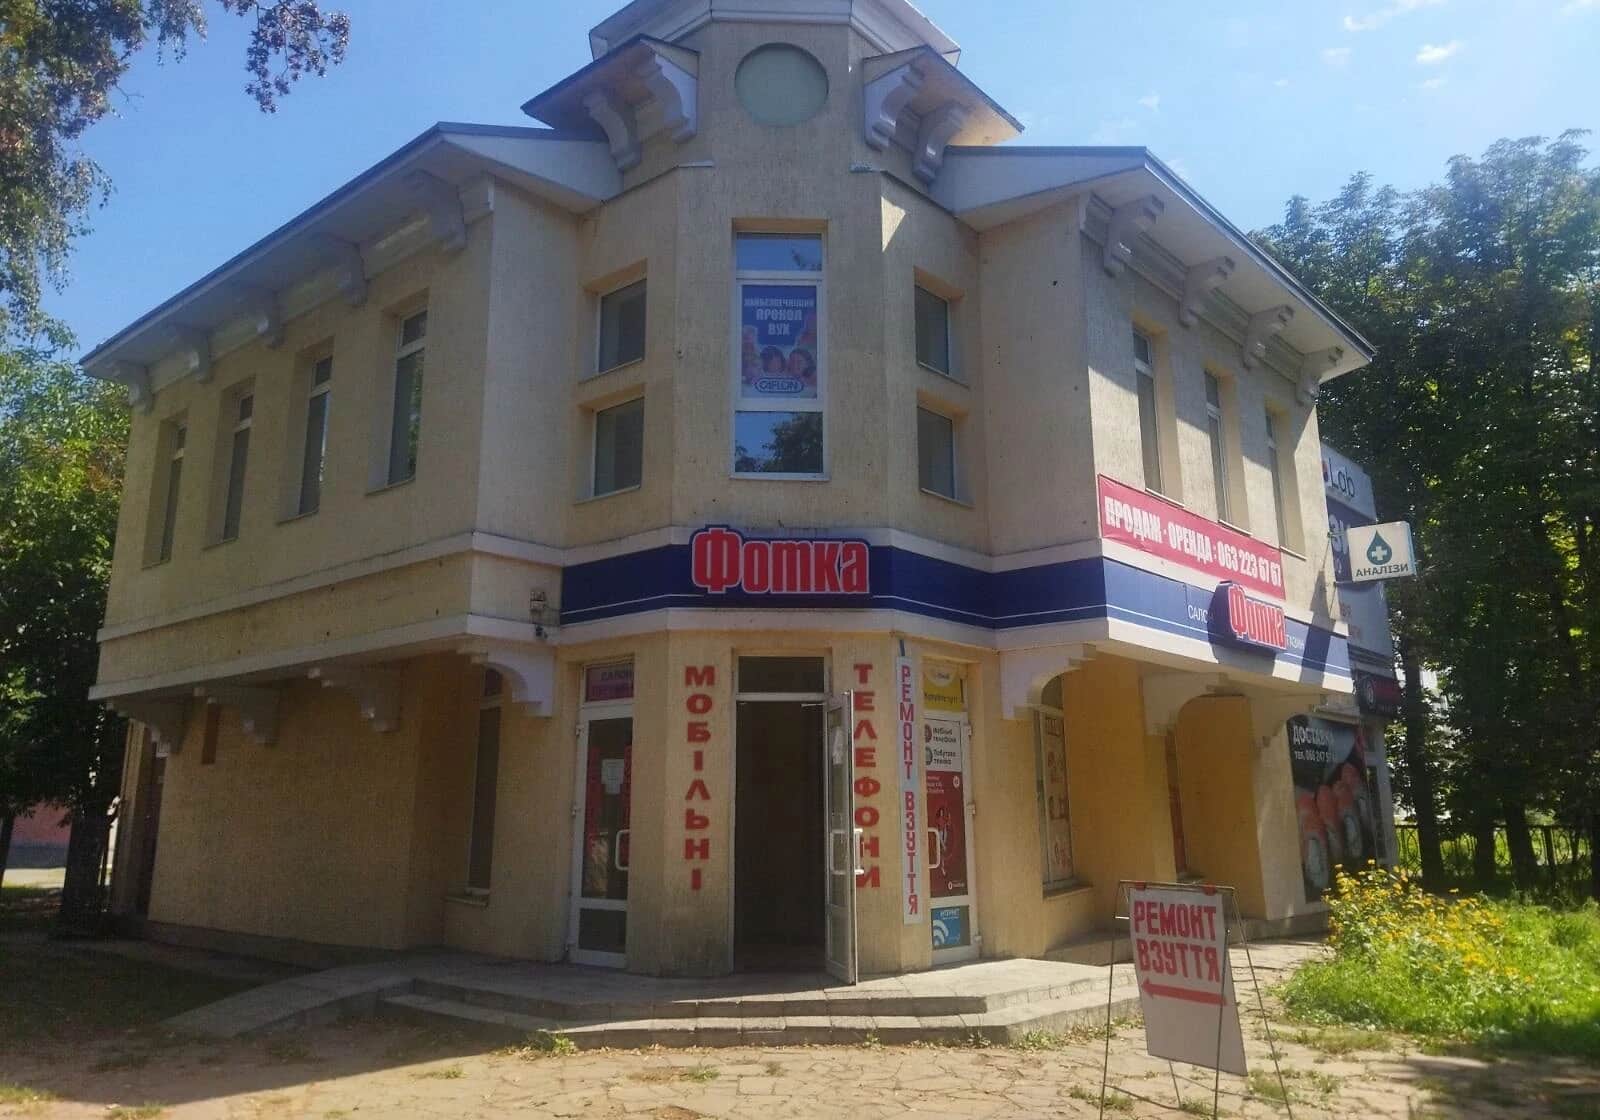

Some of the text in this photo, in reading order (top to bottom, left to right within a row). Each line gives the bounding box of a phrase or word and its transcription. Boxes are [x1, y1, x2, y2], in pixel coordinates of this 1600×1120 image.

[755, 308, 803, 321] ПРОКОЛ
[767, 322, 791, 337] ВУХ
[692, 527, 870, 594] Фотка
[1104, 495, 1282, 588] ПРОДАЖ ОРЕНДА 063 223 67 67
[1355, 563, 1410, 579] АНАЛІЗИ
[1227, 582, 1288, 650] Фотка
[684, 665, 716, 892] МОБІЛЬНІ
[853, 663, 881, 889] ТЕЛЕФОНИ
[899, 665, 919, 916] РЕМОНТ ВЗУТТЯ
[1133, 900, 1217, 941] РЕМОНТ
[1136, 937, 1221, 983] ВЗУТТЯ
